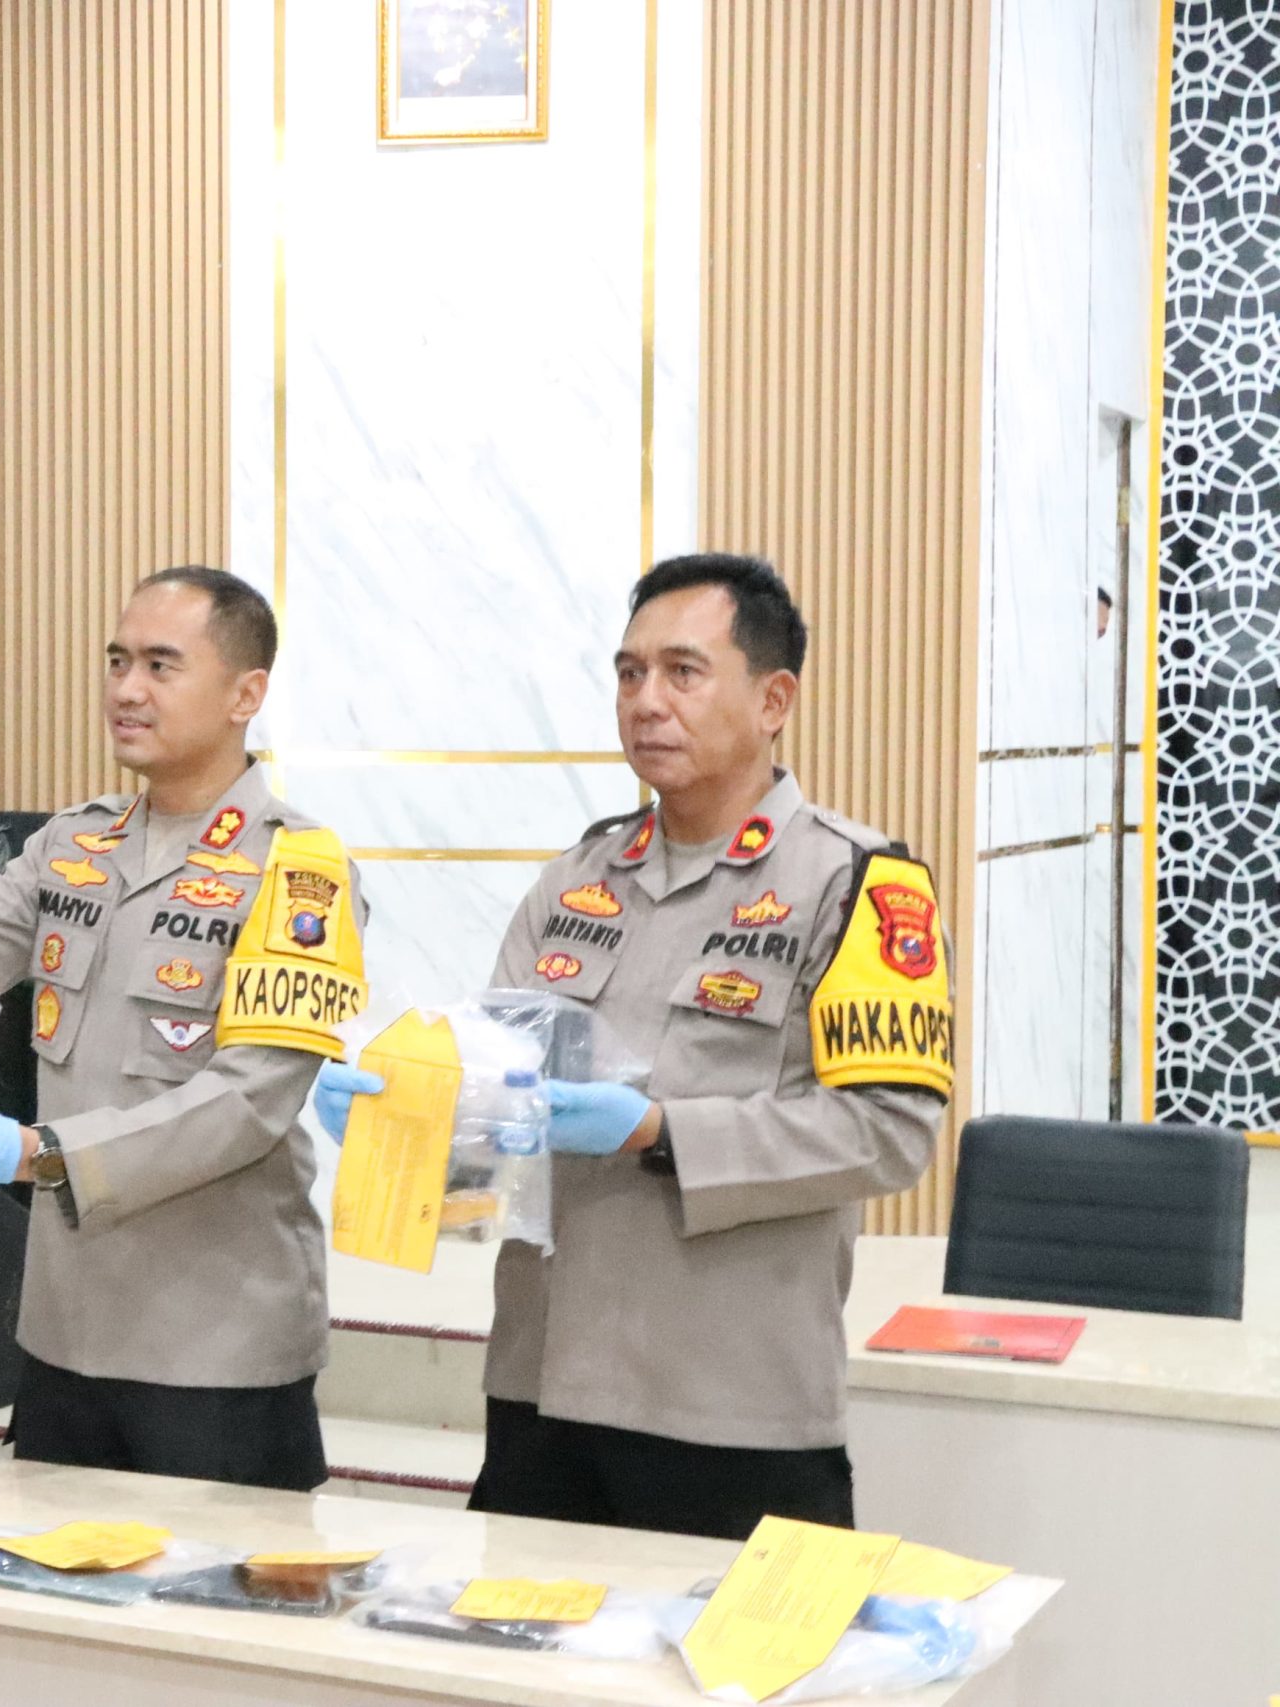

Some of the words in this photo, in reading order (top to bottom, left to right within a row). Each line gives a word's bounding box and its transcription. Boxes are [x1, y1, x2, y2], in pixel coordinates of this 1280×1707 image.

[38, 887, 103, 927] WAHYU
[150, 911, 240, 948] POLRI
[702, 932, 799, 965] POLRI
[234, 968, 359, 1024] KAOPSRES
